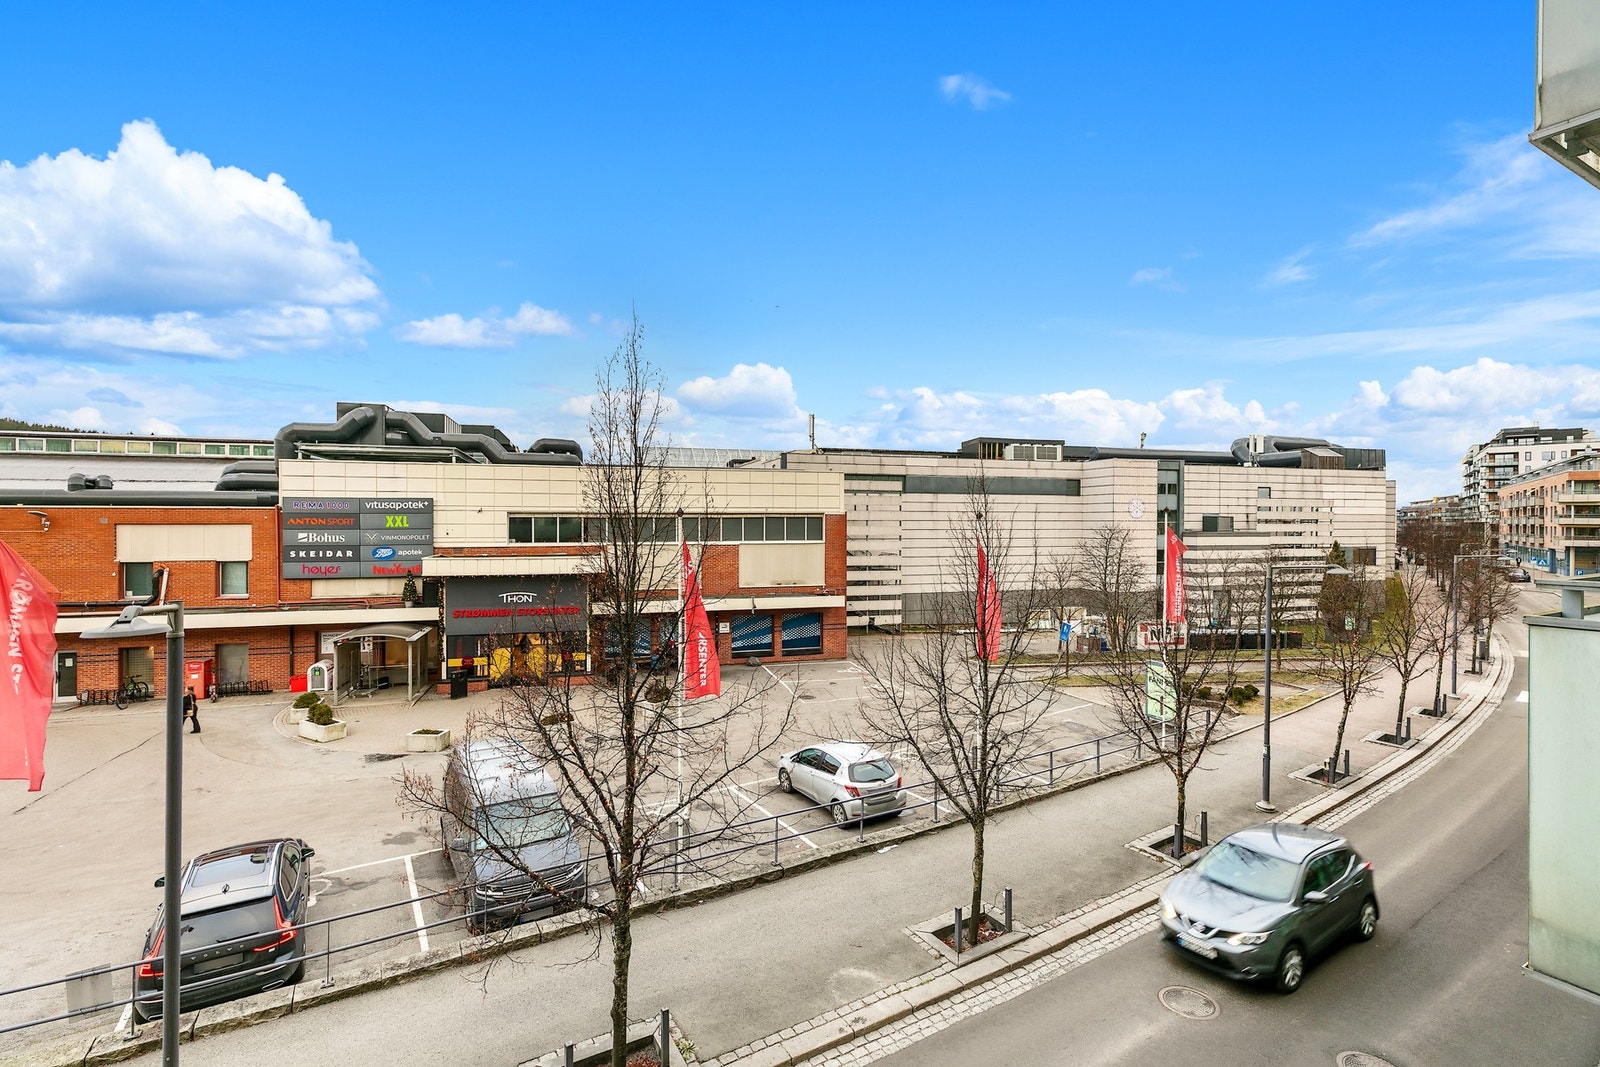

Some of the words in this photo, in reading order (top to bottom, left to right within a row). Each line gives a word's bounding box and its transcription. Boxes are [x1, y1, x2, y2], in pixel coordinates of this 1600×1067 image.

[293, 501, 324, 509] REMA
[326, 501, 350, 510] 1000
[287, 517, 326, 525] ANTON
[327, 517, 355, 525] SPORT
[385, 515, 409, 527] XXL
[308, 532, 346, 543] Bohus
[290, 550, 353, 558] SKEIDAR
[302, 563, 341, 576] høyer
[499, 592, 537, 604] THON
[453, 608, 513, 618] STRØMMEN
[517, 606, 580, 616] STORSENTER
[190, 944, 245, 960] VOLVO
